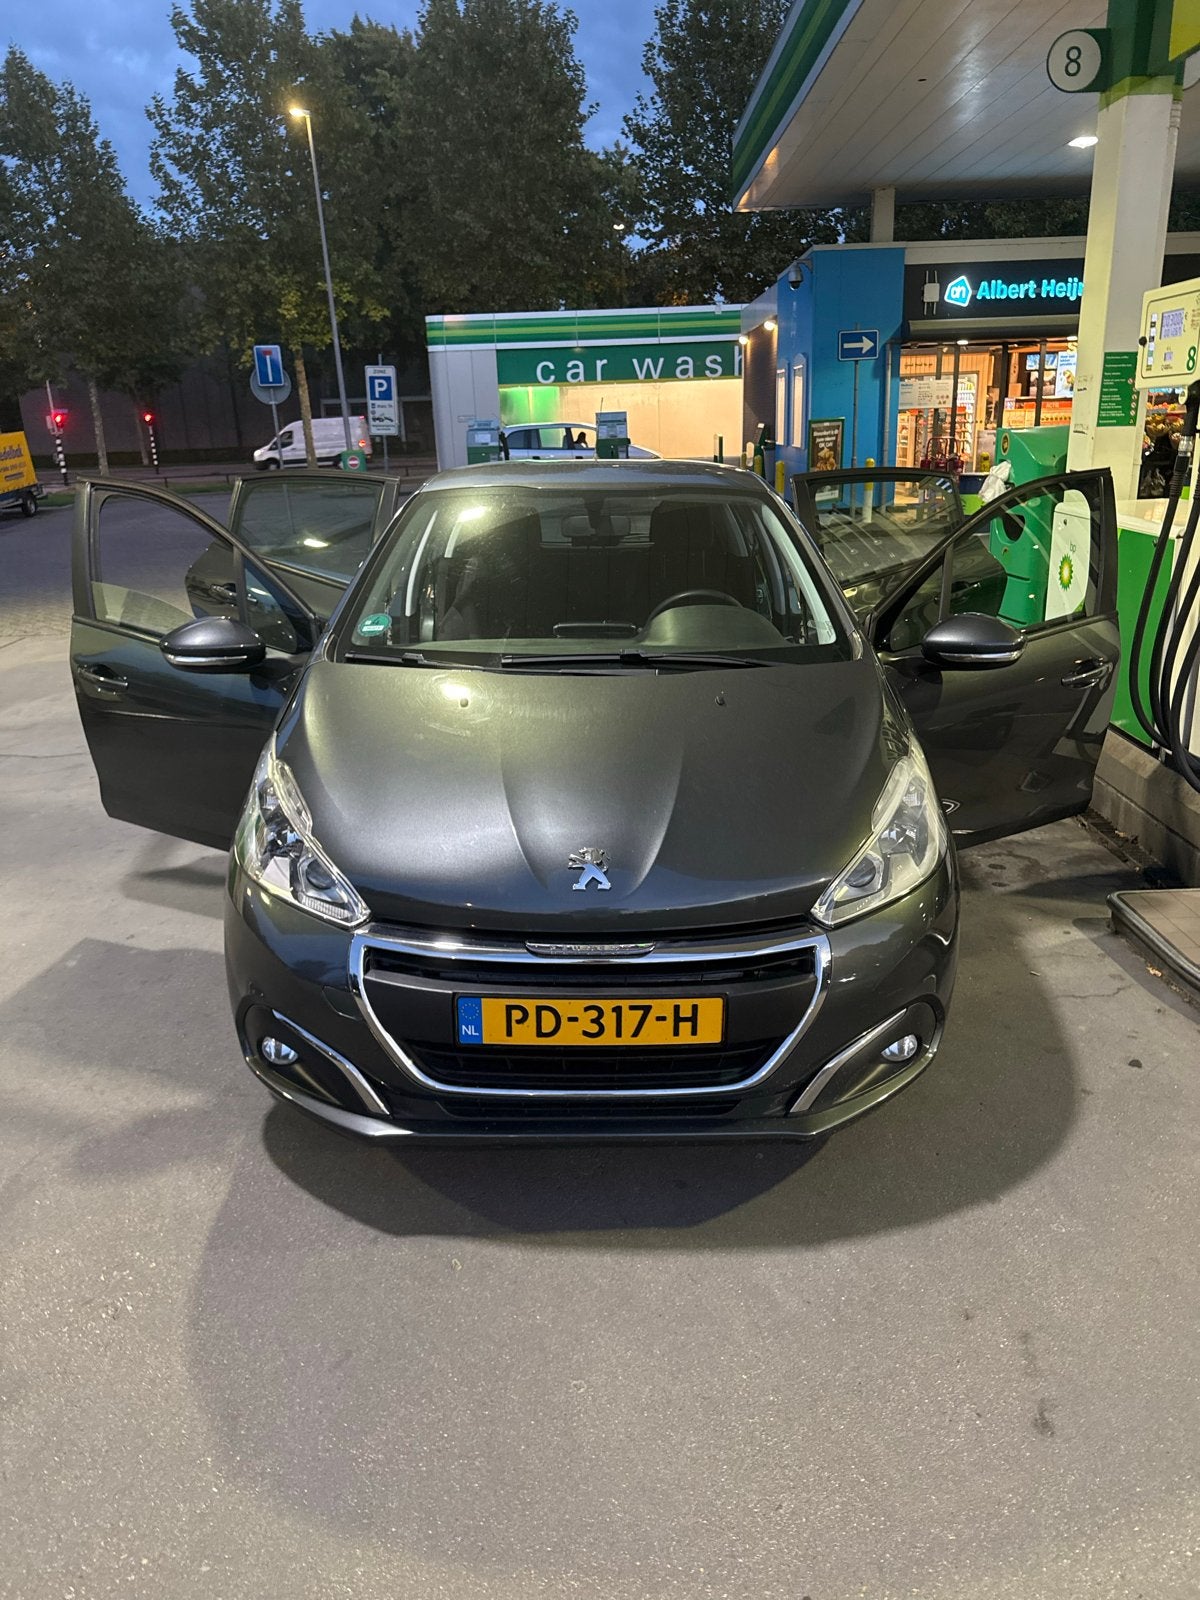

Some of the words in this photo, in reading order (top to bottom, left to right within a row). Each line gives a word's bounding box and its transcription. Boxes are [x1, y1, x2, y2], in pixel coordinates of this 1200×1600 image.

[1064, 45, 1082, 77] 8
[976, 279, 1037, 300] Albert
[536, 358, 608, 384] car
[1186, 345, 1197, 371] 8
[374, 379, 388, 399] P
[1069, 540, 1077, 553] bp
[462, 1025, 479, 1036] NL
[505, 1004, 699, 1039] PD-317-H
